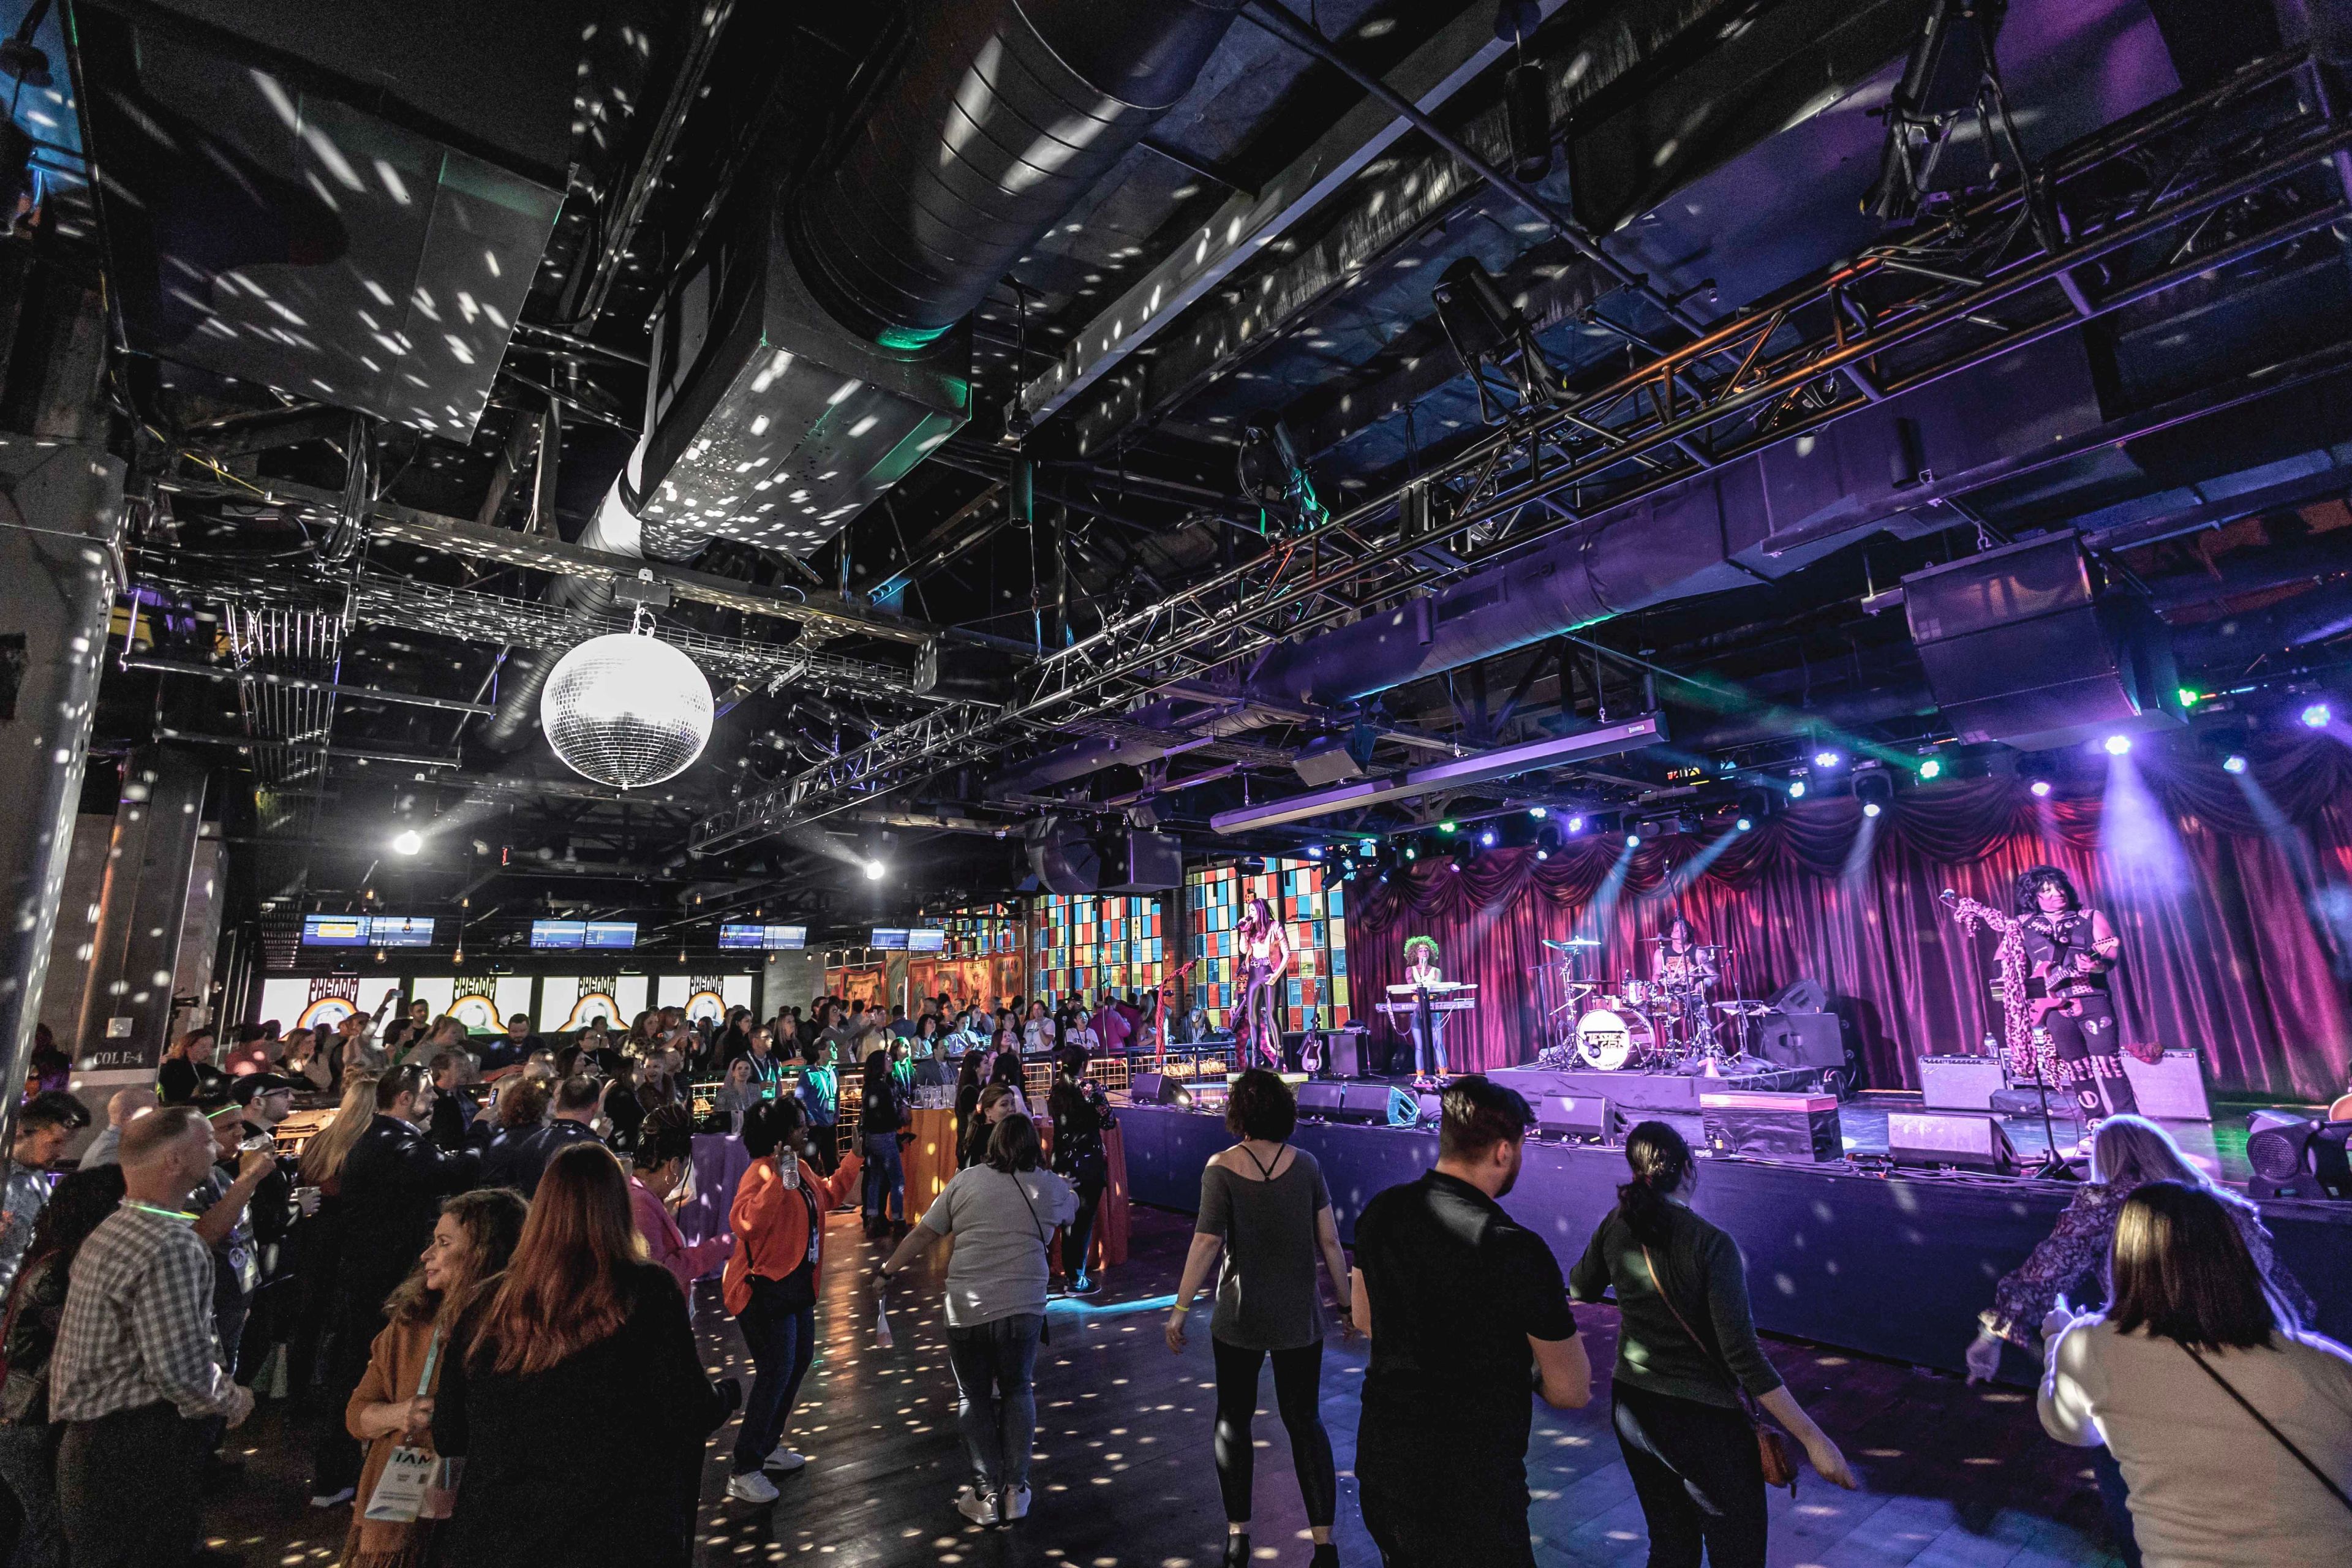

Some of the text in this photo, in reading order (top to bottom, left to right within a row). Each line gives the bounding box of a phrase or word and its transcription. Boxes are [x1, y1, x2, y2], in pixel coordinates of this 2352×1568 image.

[966, 960, 987, 969] ELECTRA
[93, 1052, 143, 1065] COL E-4
